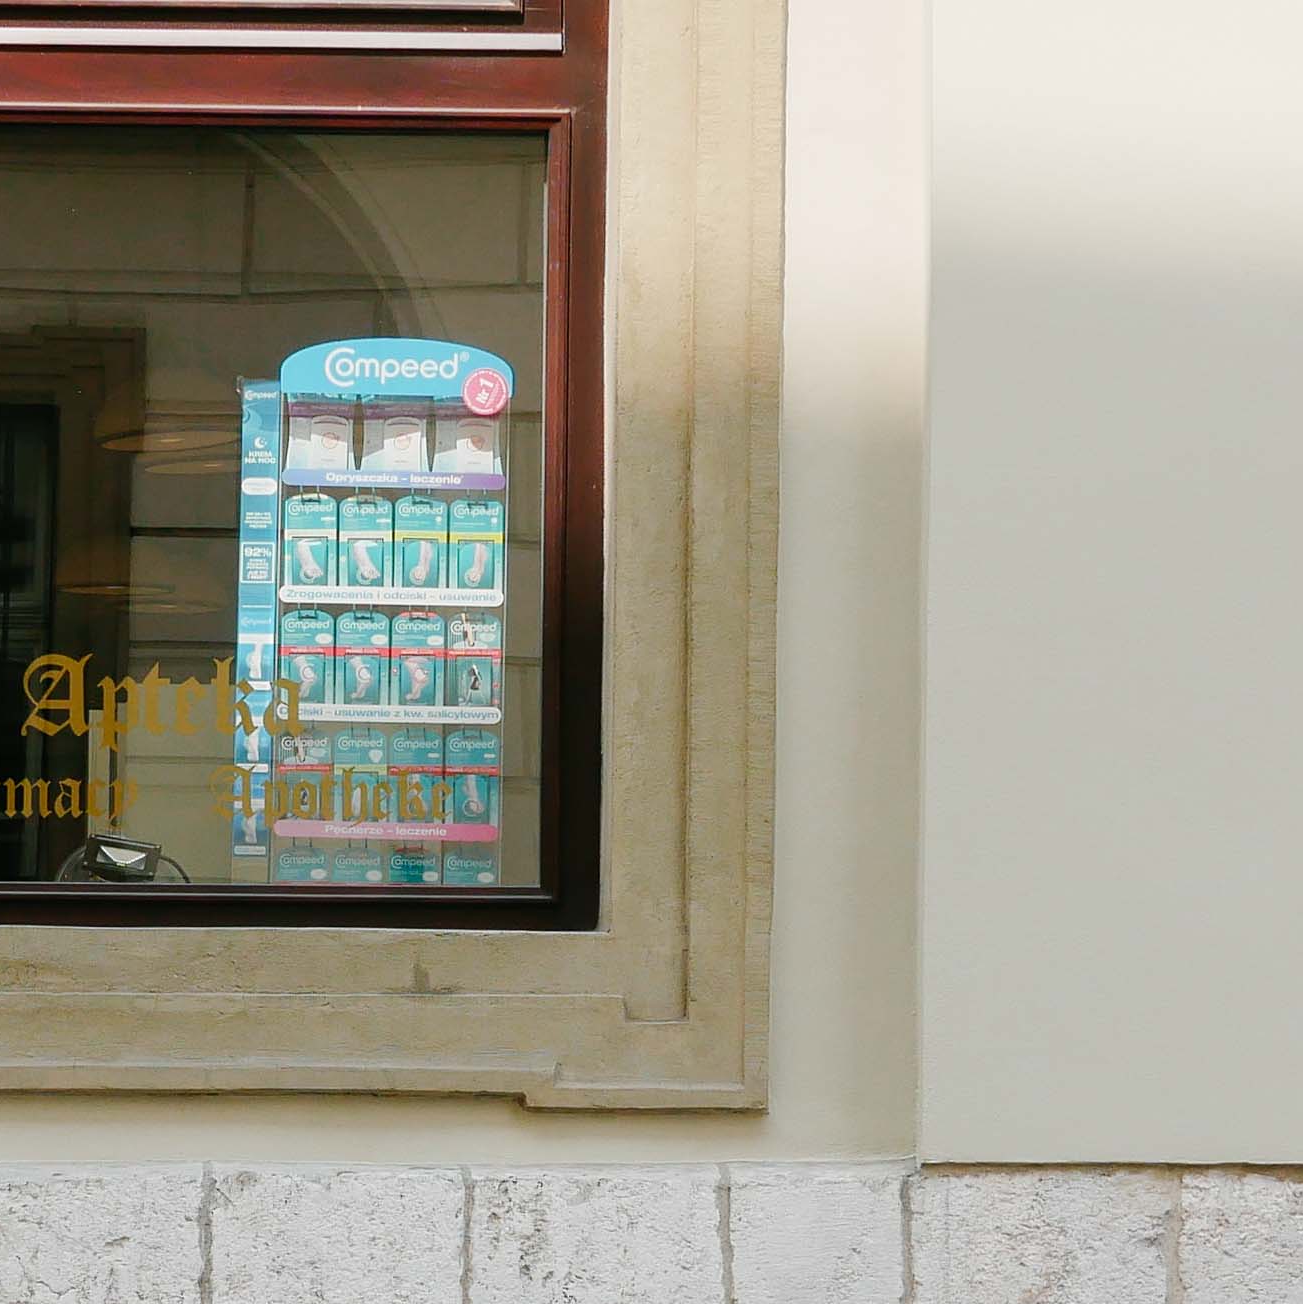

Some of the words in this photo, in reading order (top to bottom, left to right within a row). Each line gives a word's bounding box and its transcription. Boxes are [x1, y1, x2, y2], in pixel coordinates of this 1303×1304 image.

[326, 472, 398, 485] Opryszczka
[288, 503, 333, 515] Compeed
[342, 503, 388, 517] Compeed
[398, 503, 443, 517] Compeed
[453, 503, 499, 518] Compeed
[383, 590, 427, 601] odciski
[439, 592, 496, 602] usuwanie
[285, 618, 330, 631] Compeed
[340, 619, 385, 632] Compeed
[395, 620, 441, 633] Compeed
[450, 620, 498, 634] Compeed
[21, 653, 305, 752] Apteka
[334, 708, 390, 718] usuwanie
[281, 736, 328, 749] Compeed
[338, 736, 384, 750] Compeed
[393, 737, 439, 751] Compeed
[450, 737, 495, 751] Compeed
[208, 763, 453, 830] Apotheke
[279, 854, 326, 867] Compeed
[335, 854, 381, 868] Compeed
[391, 855, 437, 869] Compeed
[446, 856, 493, 869] Compeed
